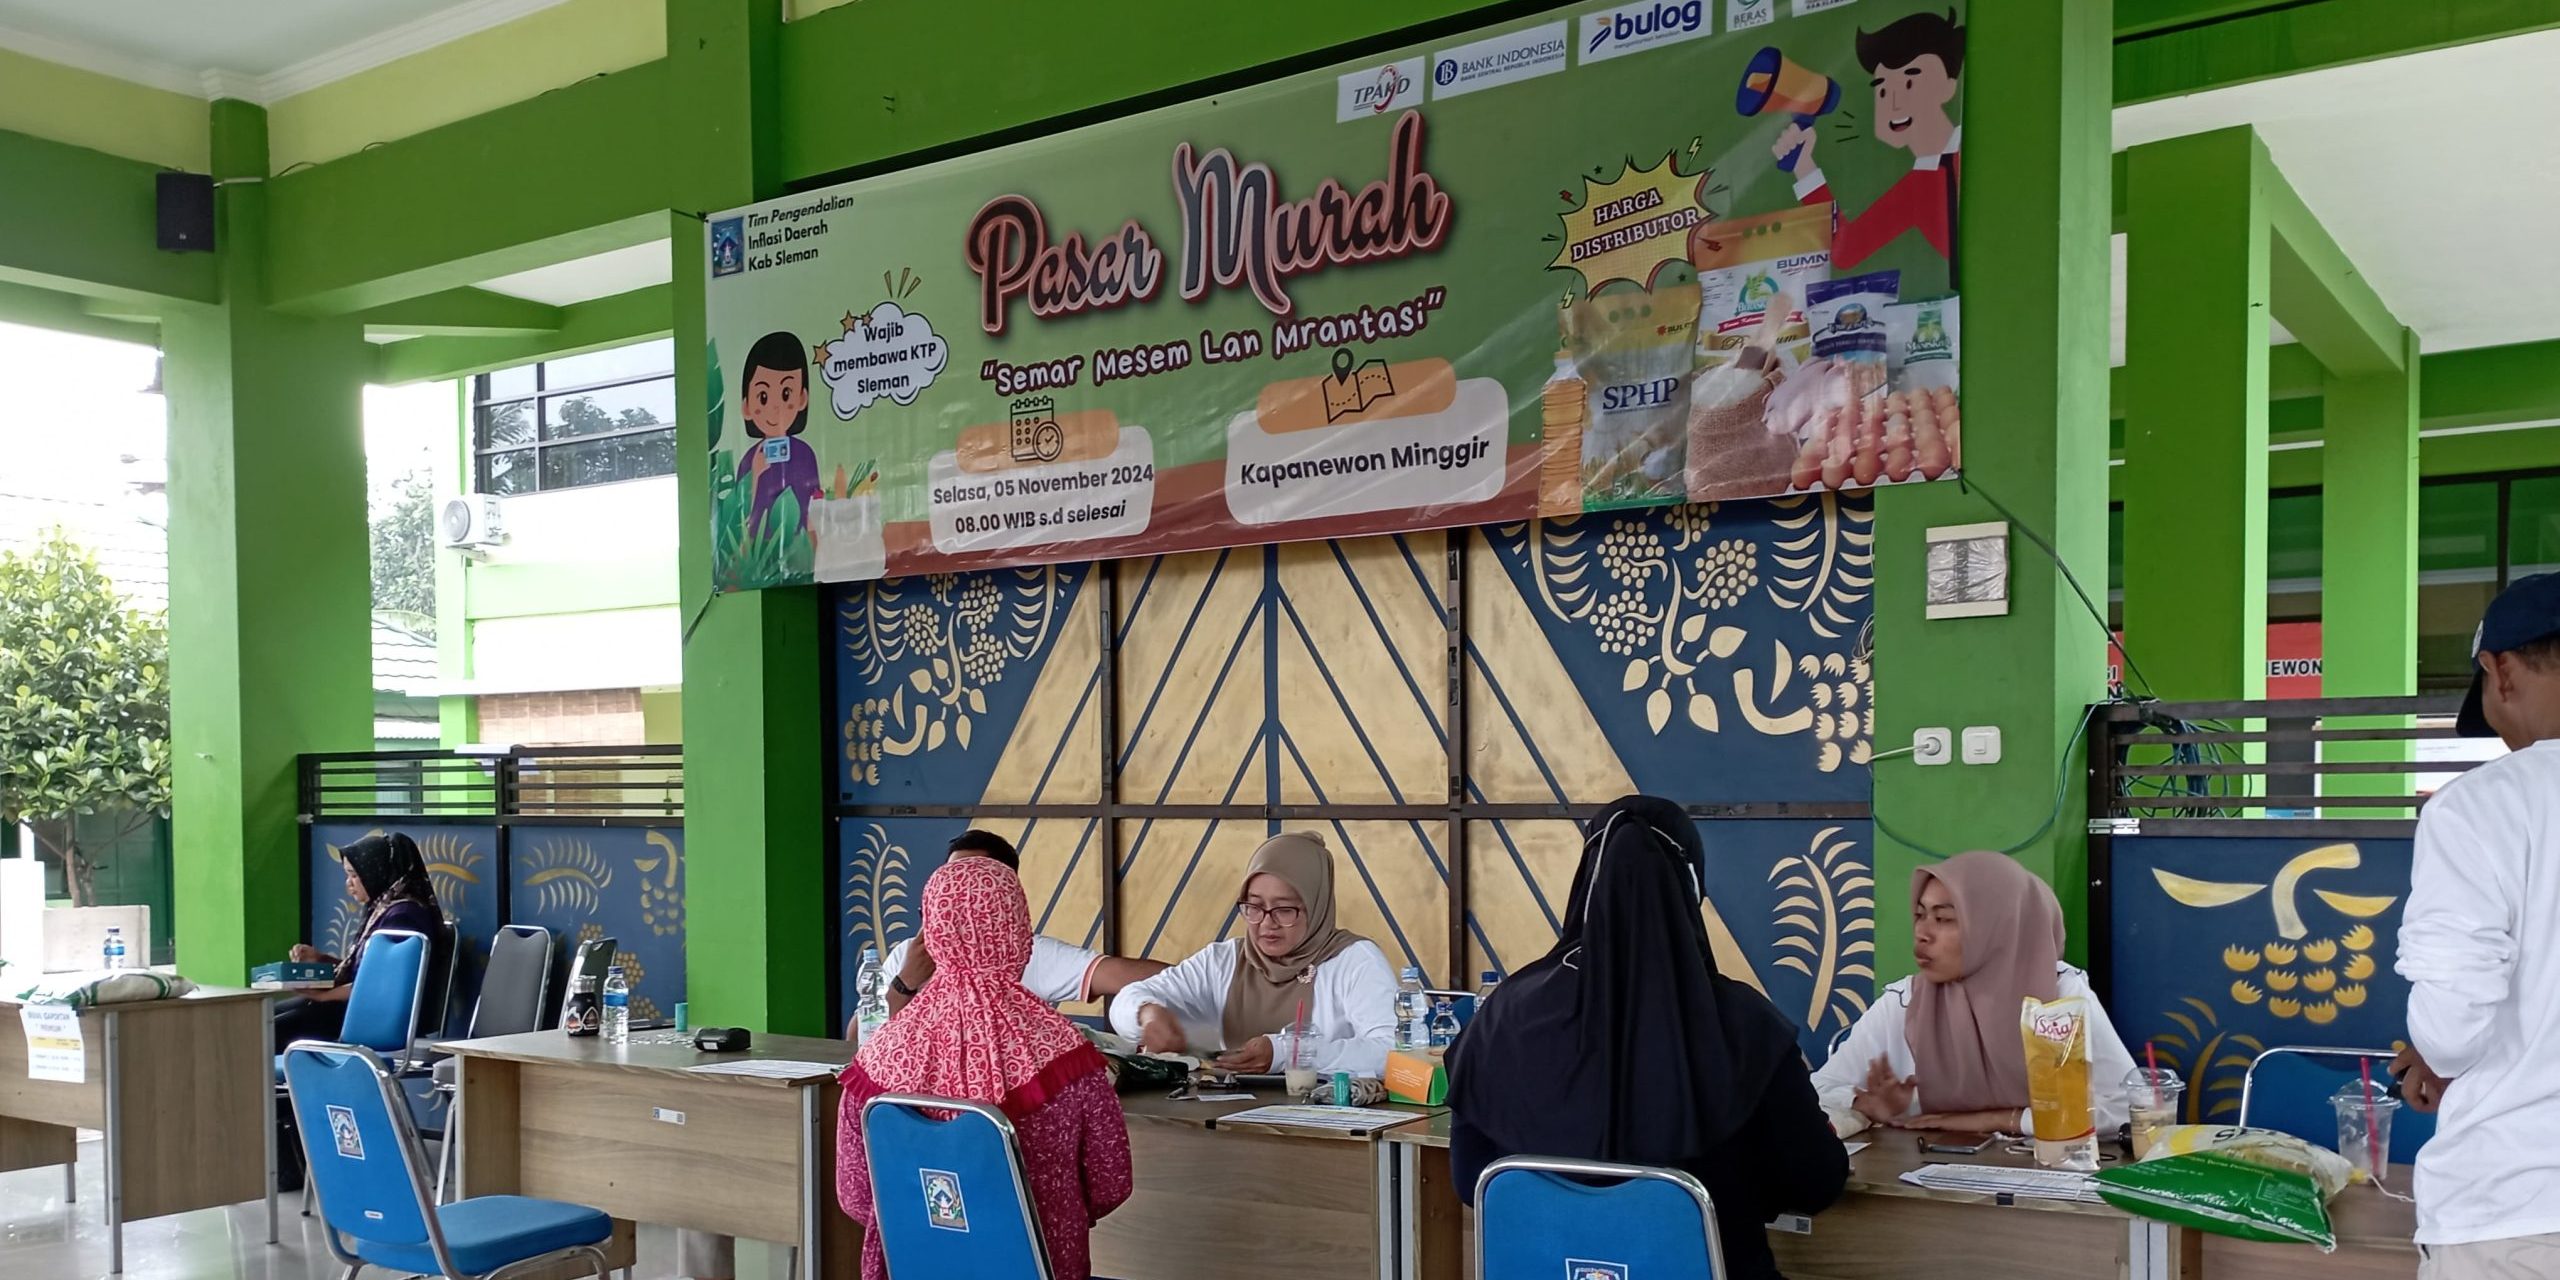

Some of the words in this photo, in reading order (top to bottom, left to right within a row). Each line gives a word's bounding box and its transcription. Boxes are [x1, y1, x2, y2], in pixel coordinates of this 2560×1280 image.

[1614, 0, 1702, 40] bulog
[1734, 8, 1767, 25] BERAS
[1461, 56, 1493, 74] BANK
[1496, 39, 1565, 66] INDONESIA
[748, 212, 769, 229] Tim
[771, 195, 854, 223] Pengendalian
[966, 194, 1161, 333] Pasar
[1172, 109, 1450, 314] Murah
[1594, 188, 1662, 224] HARGA
[748, 228, 783, 250] Inflasi
[784, 218, 829, 242] Daerah
[1571, 208, 1699, 261] DISTRIBUTOR
[748, 253, 773, 272] Kab
[775, 247, 819, 267] Sleman
[1776, 253, 1830, 270] BUMN
[863, 321, 904, 344] Wajib
[833, 349, 908, 373] membawa
[910, 342, 937, 361] KTP
[1095, 343, 1190, 384] Mesem
[1202, 332, 1260, 360] Lan
[857, 374, 910, 394] Sleman
[1602, 377, 1680, 410] SPHP
[1240, 451, 1386, 488] Kapanewon
[1391, 435, 1490, 471] Minggir
[933, 485, 991, 505] Selasa,
[994, 480, 1015, 498] 05
[1018, 471, 1108, 496] November
[1111, 463, 1154, 486] 2024
[955, 514, 1001, 534] 08.00
[1003, 510, 1036, 530] WIB
[1039, 506, 1064, 527] s.d
[1067, 499, 1127, 524] selesai
